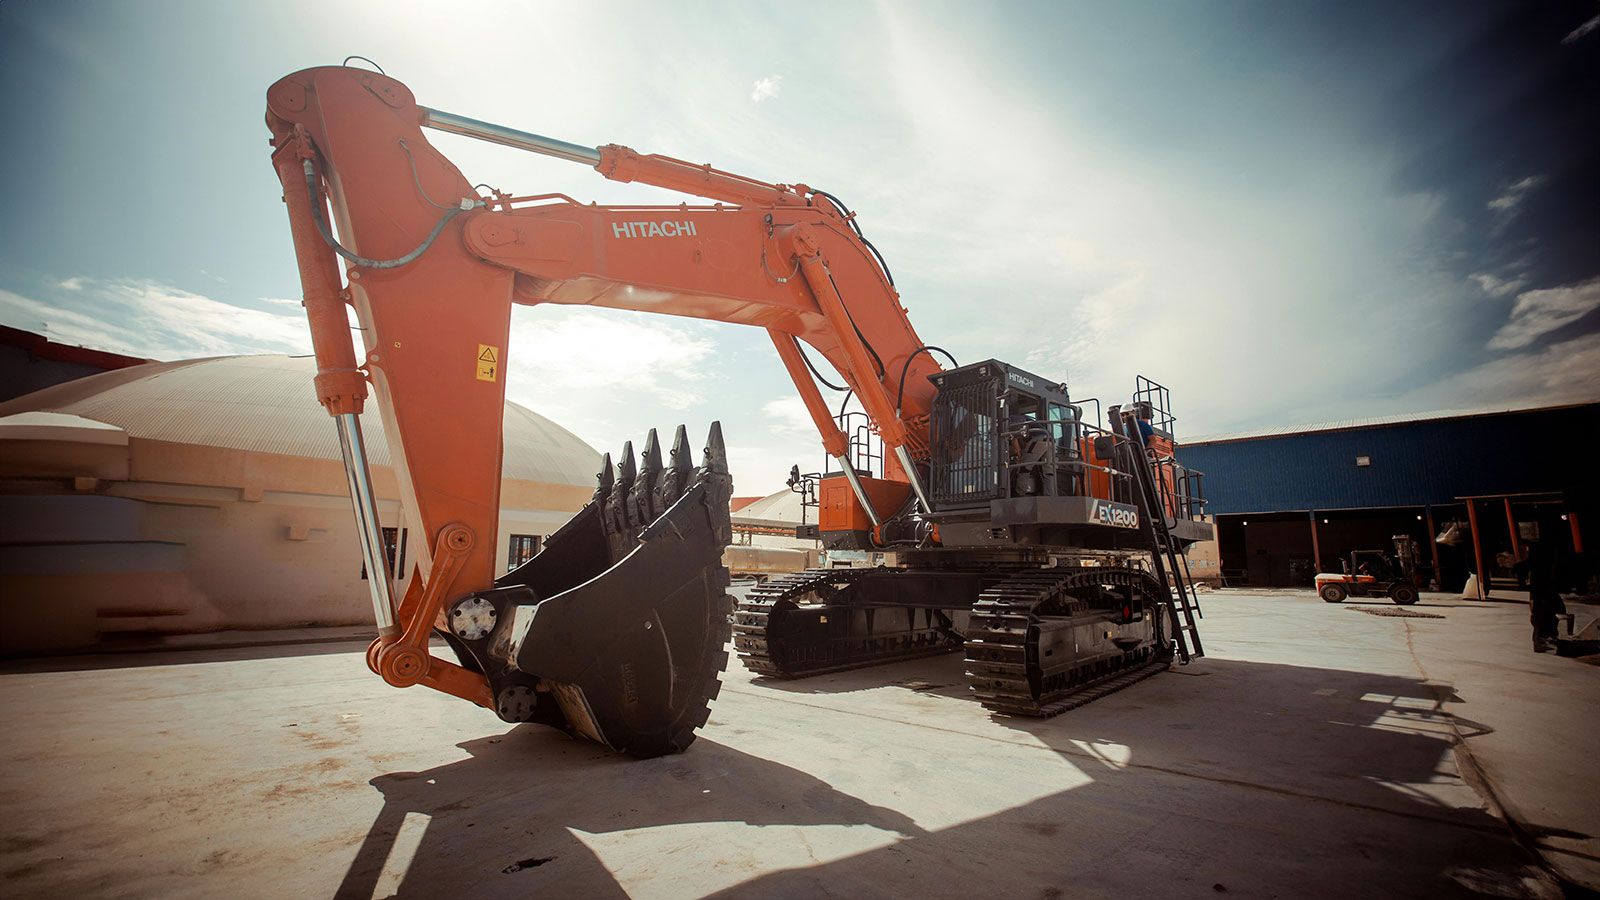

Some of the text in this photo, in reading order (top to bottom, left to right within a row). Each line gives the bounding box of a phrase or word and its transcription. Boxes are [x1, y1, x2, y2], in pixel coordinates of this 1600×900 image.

[611, 220, 697, 239] HITACHI
[1008, 372, 1034, 388] HITACHI
[1099, 504, 1138, 527] EX1200
